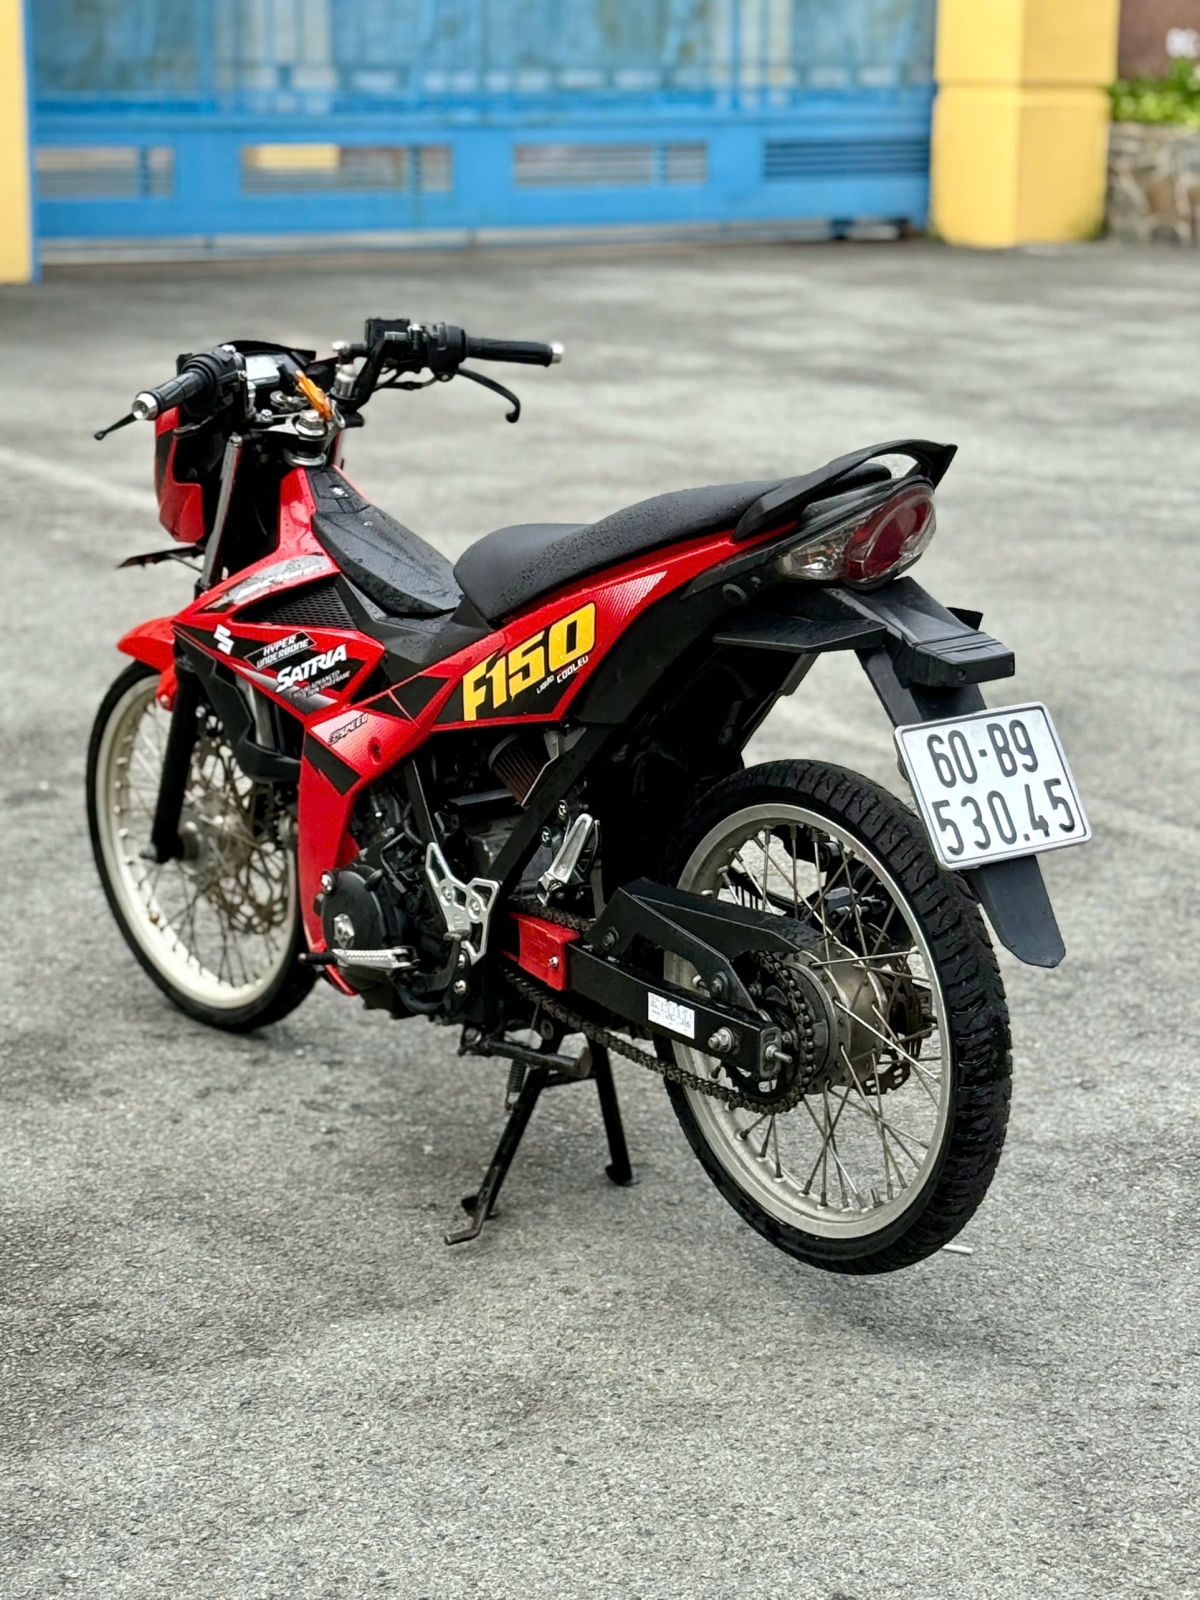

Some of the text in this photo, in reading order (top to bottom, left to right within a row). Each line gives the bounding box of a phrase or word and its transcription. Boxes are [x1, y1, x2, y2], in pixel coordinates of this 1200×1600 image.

[256, 638, 310, 669] UNDERBONE
[262, 634, 297, 657] HYPER
[275, 643, 348, 693] SATRIA
[462, 602, 596, 722] F150
[926, 719, 1039, 789] 60-B9
[931, 777, 1076, 856] 530.45
